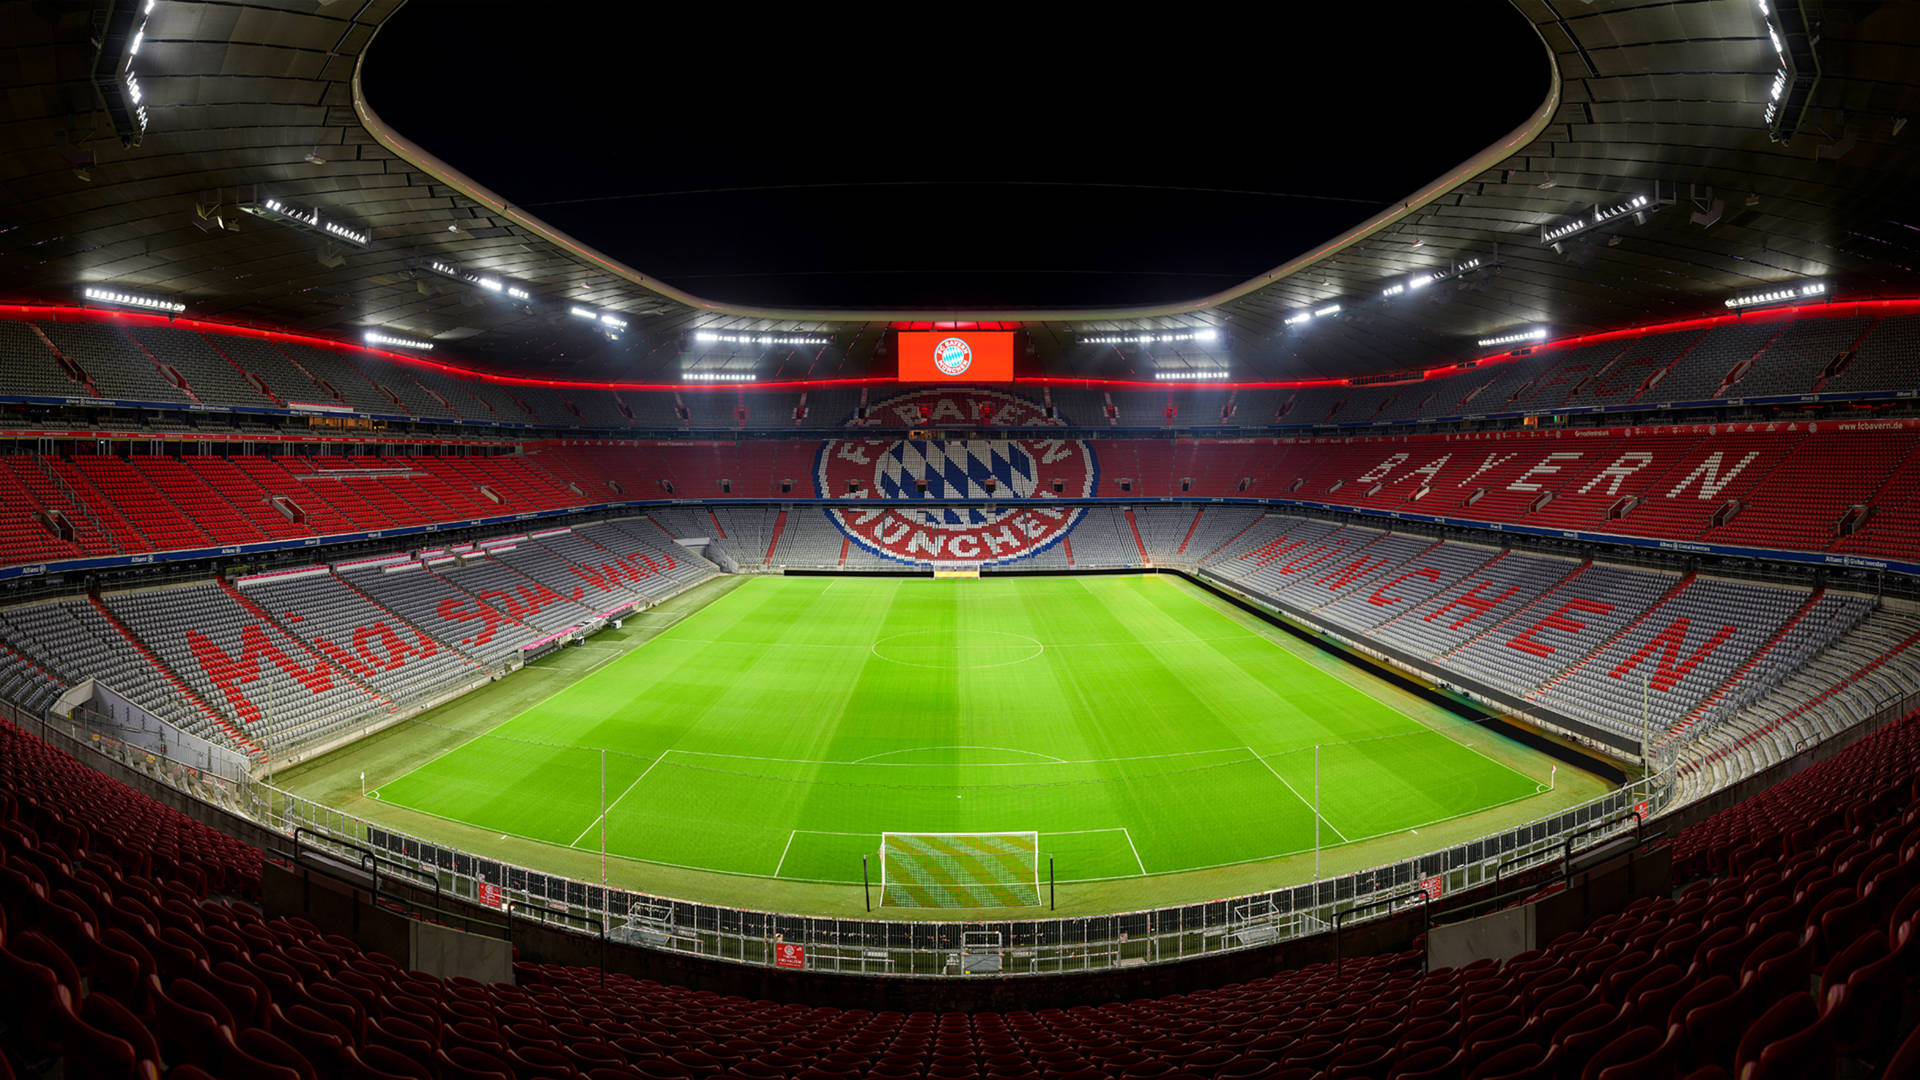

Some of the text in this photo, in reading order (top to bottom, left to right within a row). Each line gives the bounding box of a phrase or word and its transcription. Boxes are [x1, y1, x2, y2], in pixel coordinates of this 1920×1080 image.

[1838, 421, 1903, 431] www.fcbayern.de
[1357, 452, 1760, 500] BAYERN
[1240, 536, 1737, 692] MÜNCHEN
